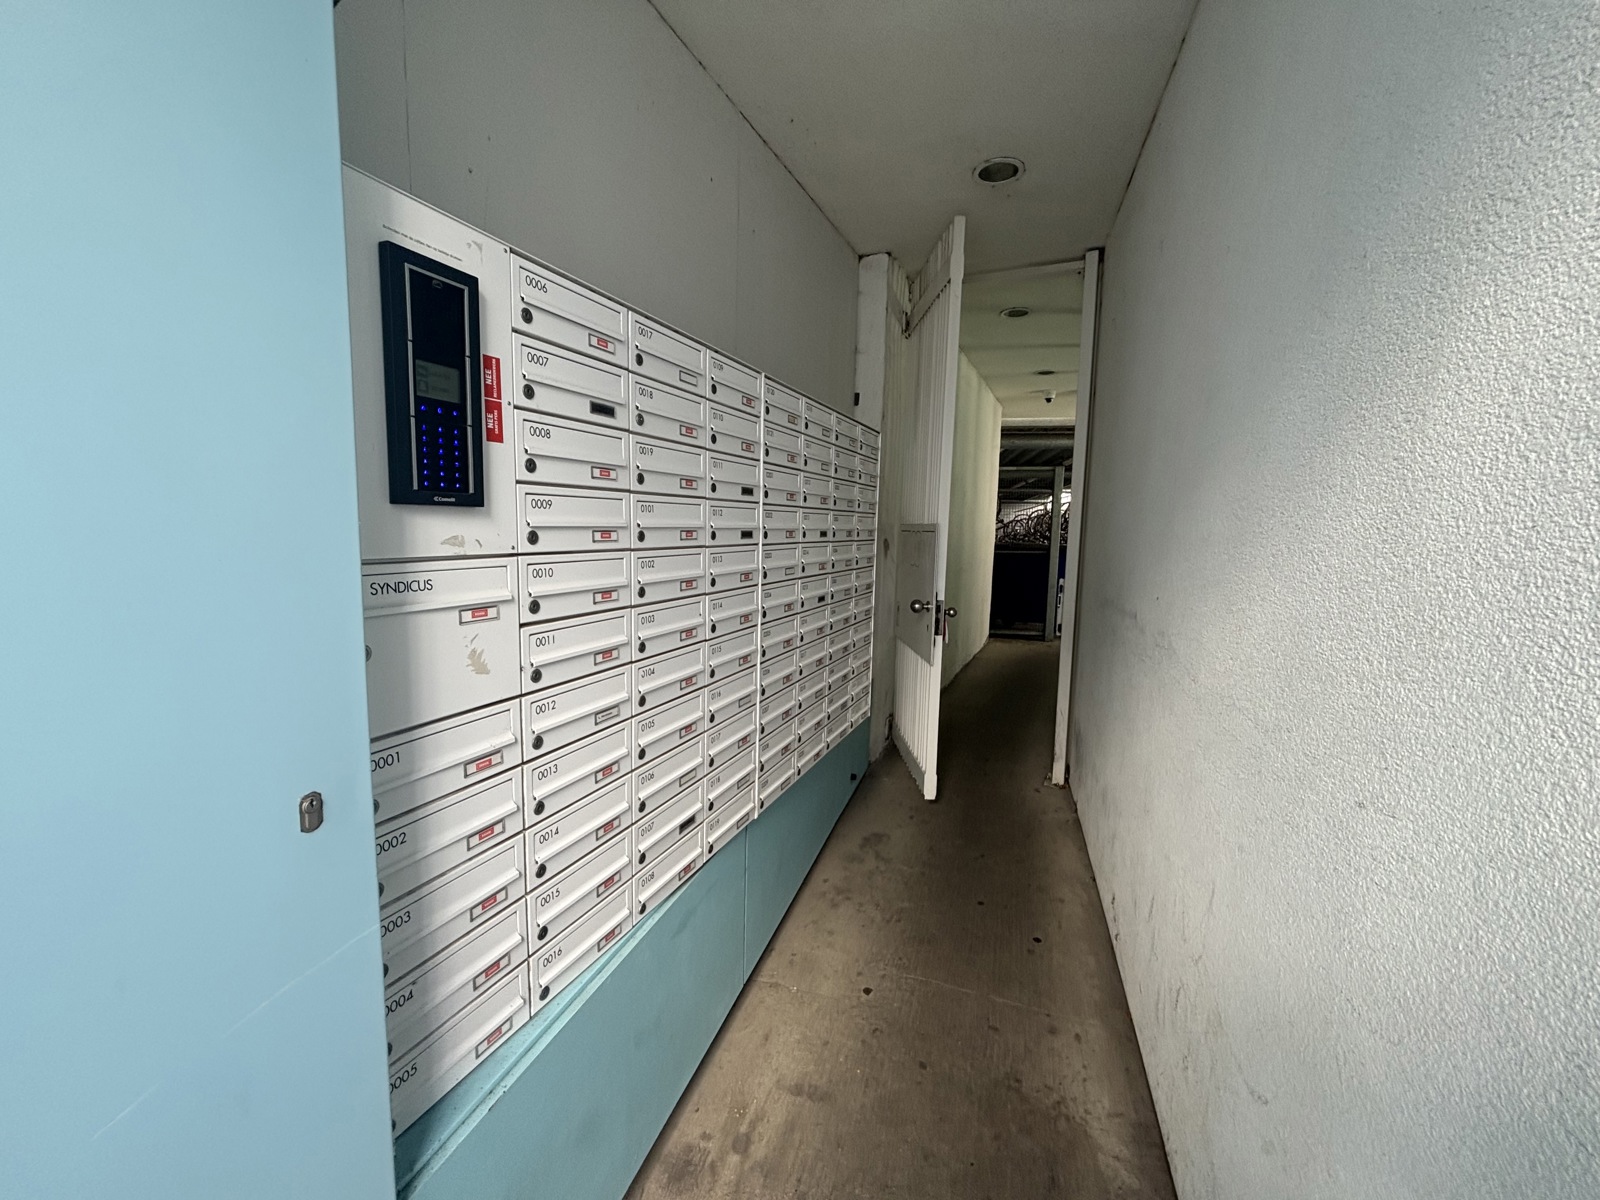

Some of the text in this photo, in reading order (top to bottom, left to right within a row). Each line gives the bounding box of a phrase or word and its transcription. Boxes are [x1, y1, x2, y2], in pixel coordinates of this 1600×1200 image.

[524, 274, 548, 295] 0006
[638, 326, 652, 340] 0017
[526, 351, 549, 368] 0007
[639, 388, 653, 400] 0018
[529, 425, 551, 440] 0008
[639, 446, 653, 456] 0019
[530, 498, 553, 510] 0009
[640, 504, 654, 513] 0101
[640, 560, 654, 568] 0102
[531, 568, 554, 579] 0010
[369, 577, 434, 596] SYNDICUS
[640, 614, 655, 624] 0103
[535, 634, 556, 648] 0011
[535, 700, 557, 715] 0012
[641, 719, 655, 732] 0105
[537, 763, 559, 781] 0013
[640, 772, 654, 784] 0106
[538, 825, 560, 845] 0014
[640, 822, 654, 837] 0107
[641, 872, 654, 886] 0108
[540, 887, 561, 908] 0015
[542, 947, 563, 969] 0016
